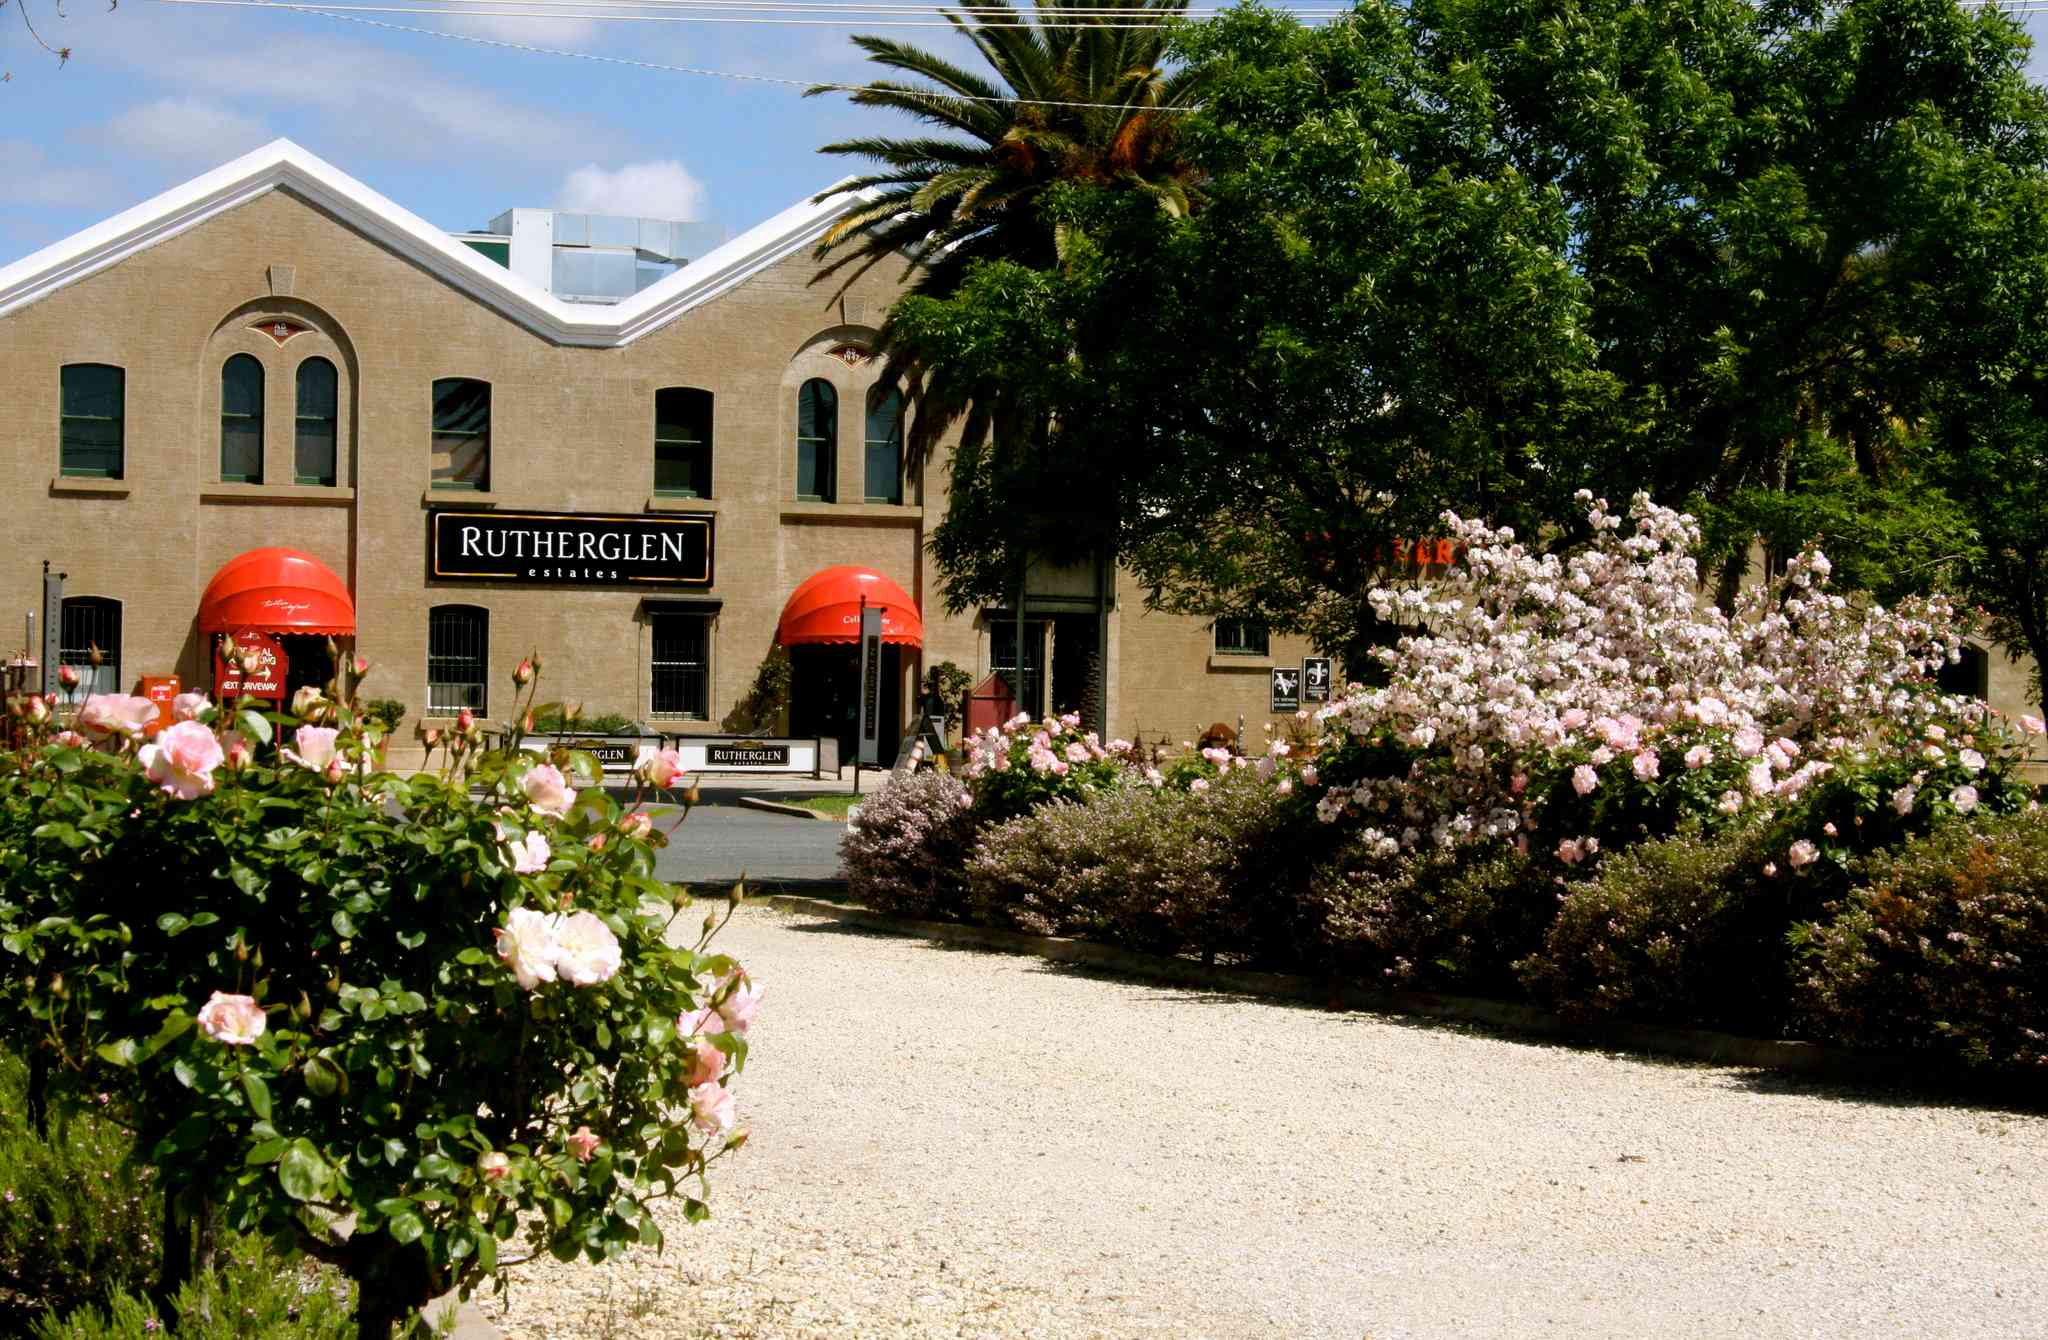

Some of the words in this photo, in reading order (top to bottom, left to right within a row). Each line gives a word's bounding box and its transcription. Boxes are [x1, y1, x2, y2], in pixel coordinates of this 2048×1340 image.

[461, 526, 685, 562] RUTHERGLEN
[528, 567, 618, 579] estates
[714, 750, 782, 761] RUTHERGLEN
